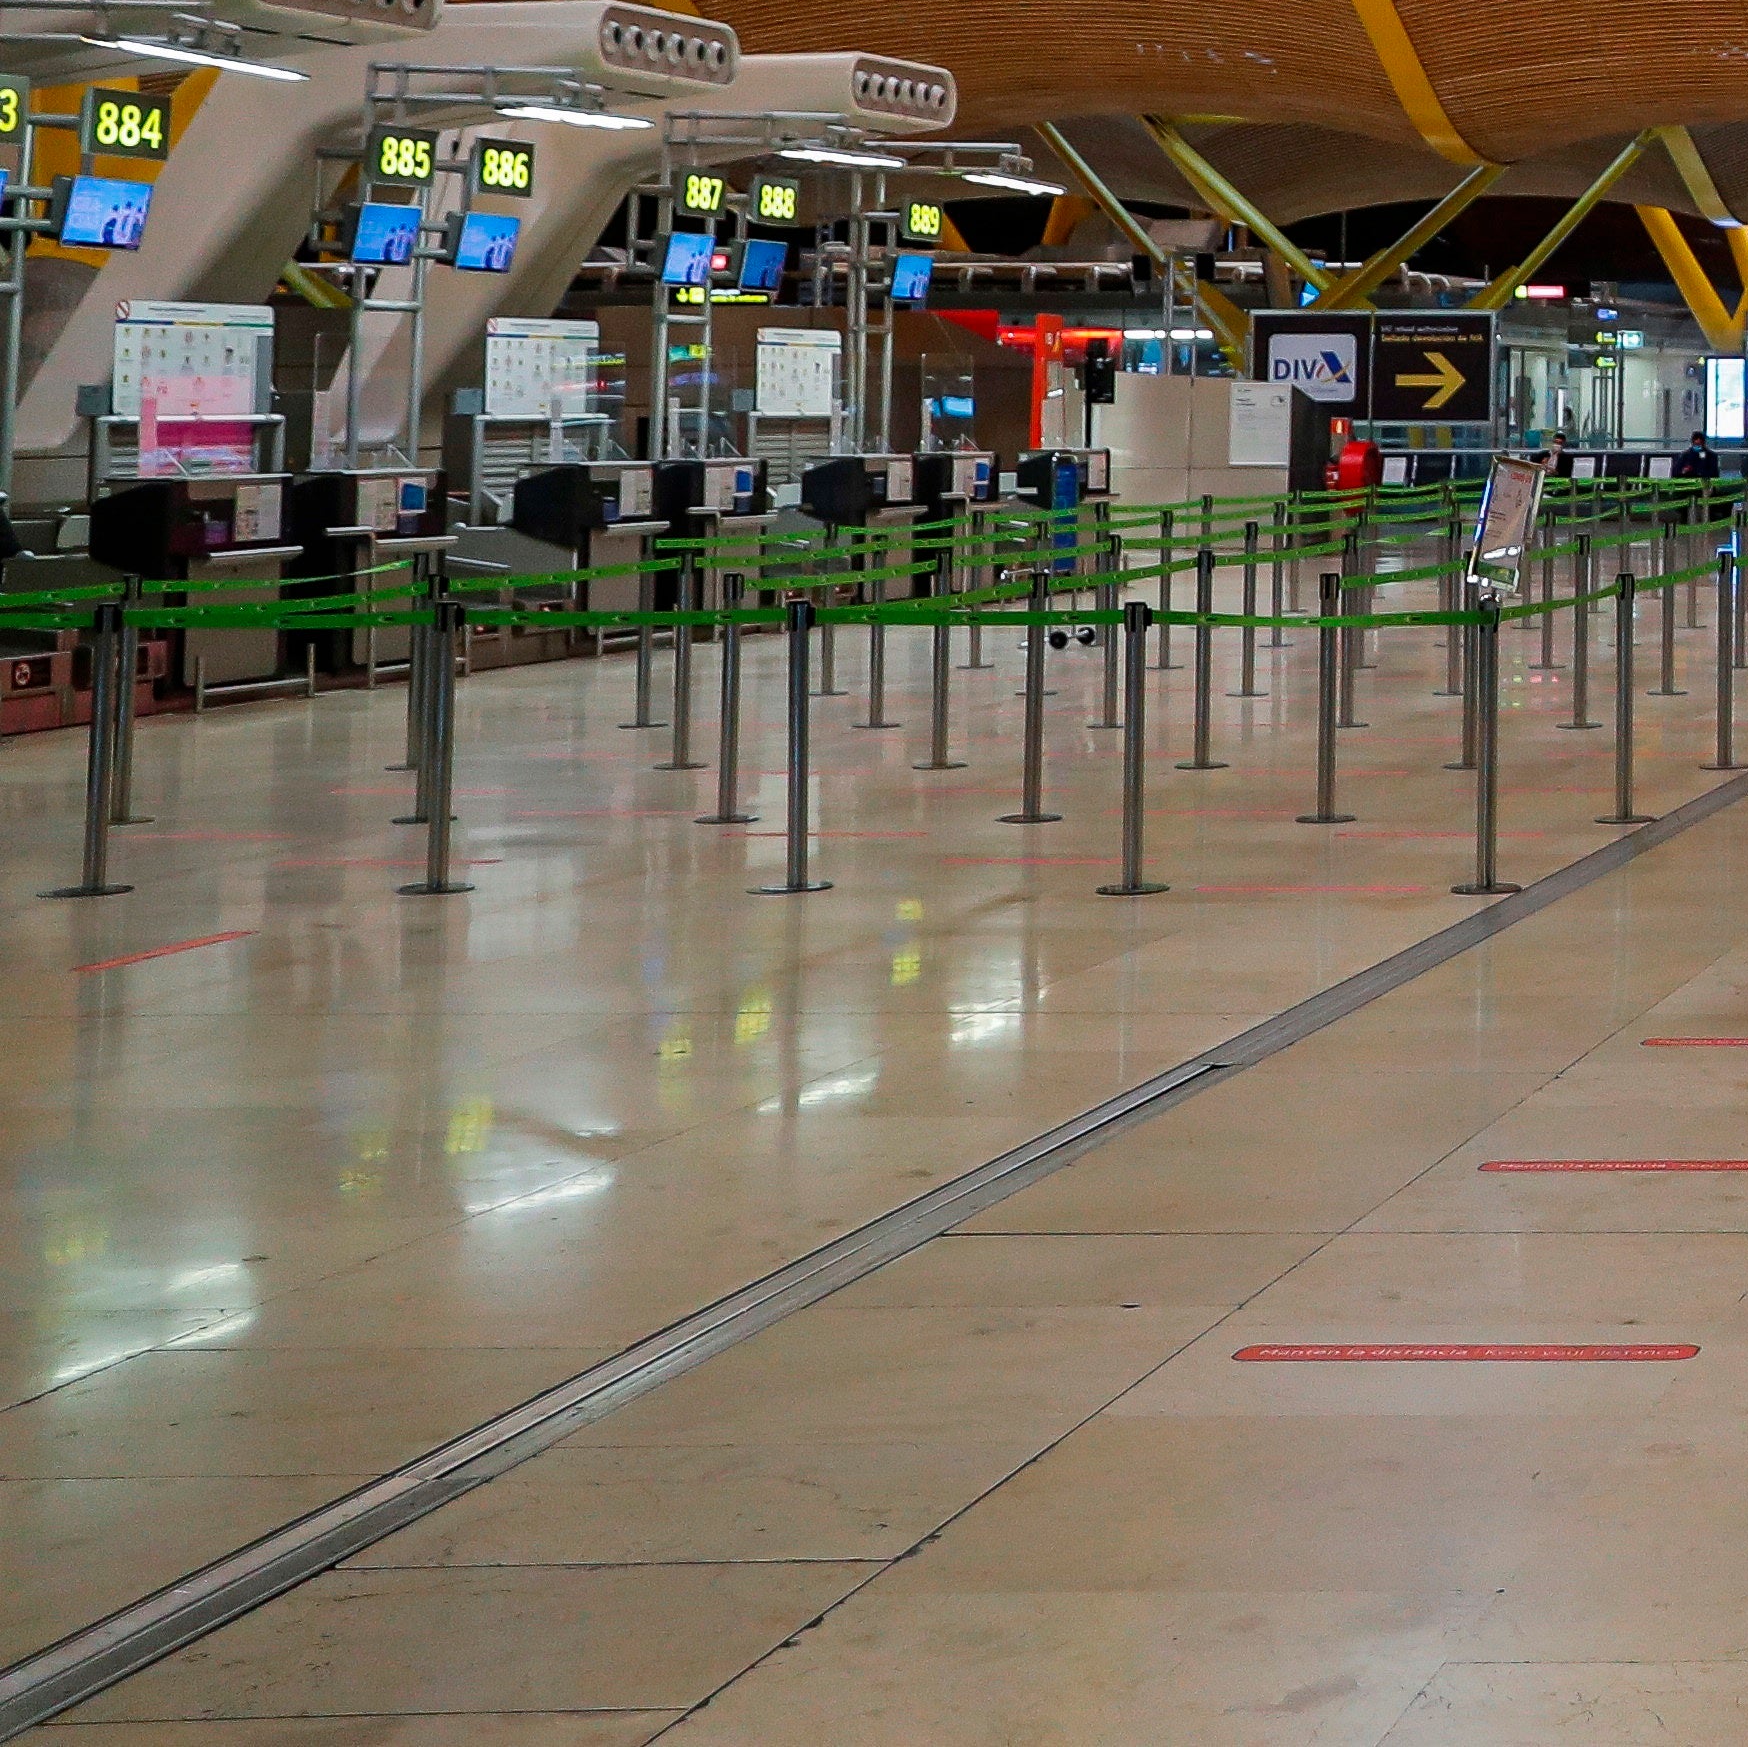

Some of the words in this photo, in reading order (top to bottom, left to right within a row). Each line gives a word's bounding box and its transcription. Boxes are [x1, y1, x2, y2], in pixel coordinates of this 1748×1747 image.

[97, 102, 162, 150] 884
[380, 136, 430, 179] 885
[482, 148, 529, 189] 886
[686, 174, 723, 212] 887
[759, 184, 795, 221] 888
[909, 203, 940, 235] 889
